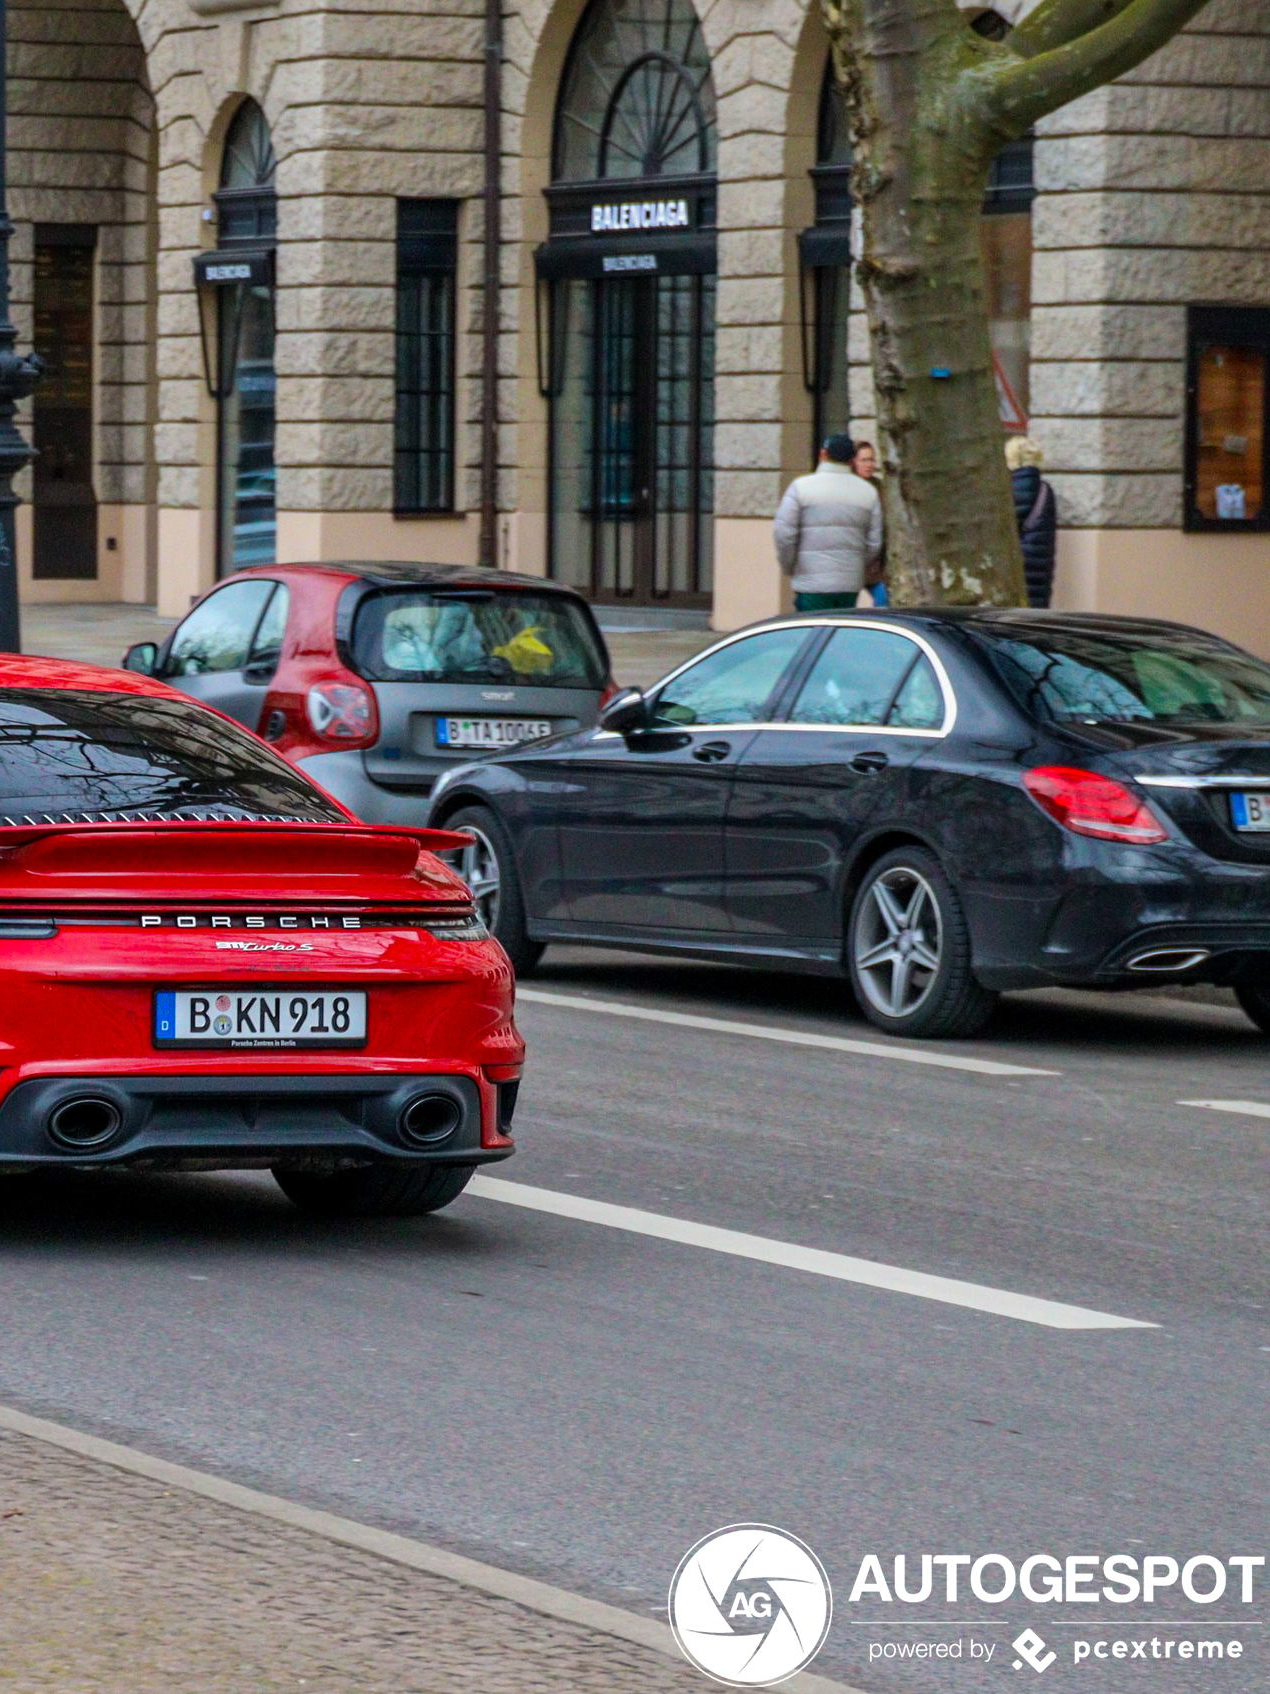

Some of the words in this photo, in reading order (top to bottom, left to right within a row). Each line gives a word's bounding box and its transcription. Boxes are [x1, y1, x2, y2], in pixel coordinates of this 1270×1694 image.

[591, 199, 689, 231] BALENCIAGA
[450, 721, 459, 740] B
[1249, 797, 1262, 821] B
[141, 915, 362, 929] PORSCHE
[297, 943, 314, 951] S
[161, 1020, 169, 1031] D
[190, 997, 210, 1033] B
[236, 997, 280, 1033] KN
[289, 997, 350, 1033] 918
[231, 1039, 253, 1047] Porsche
[253, 1039, 274, 1047] Zentren
[280, 1039, 297, 1047] Berlin
